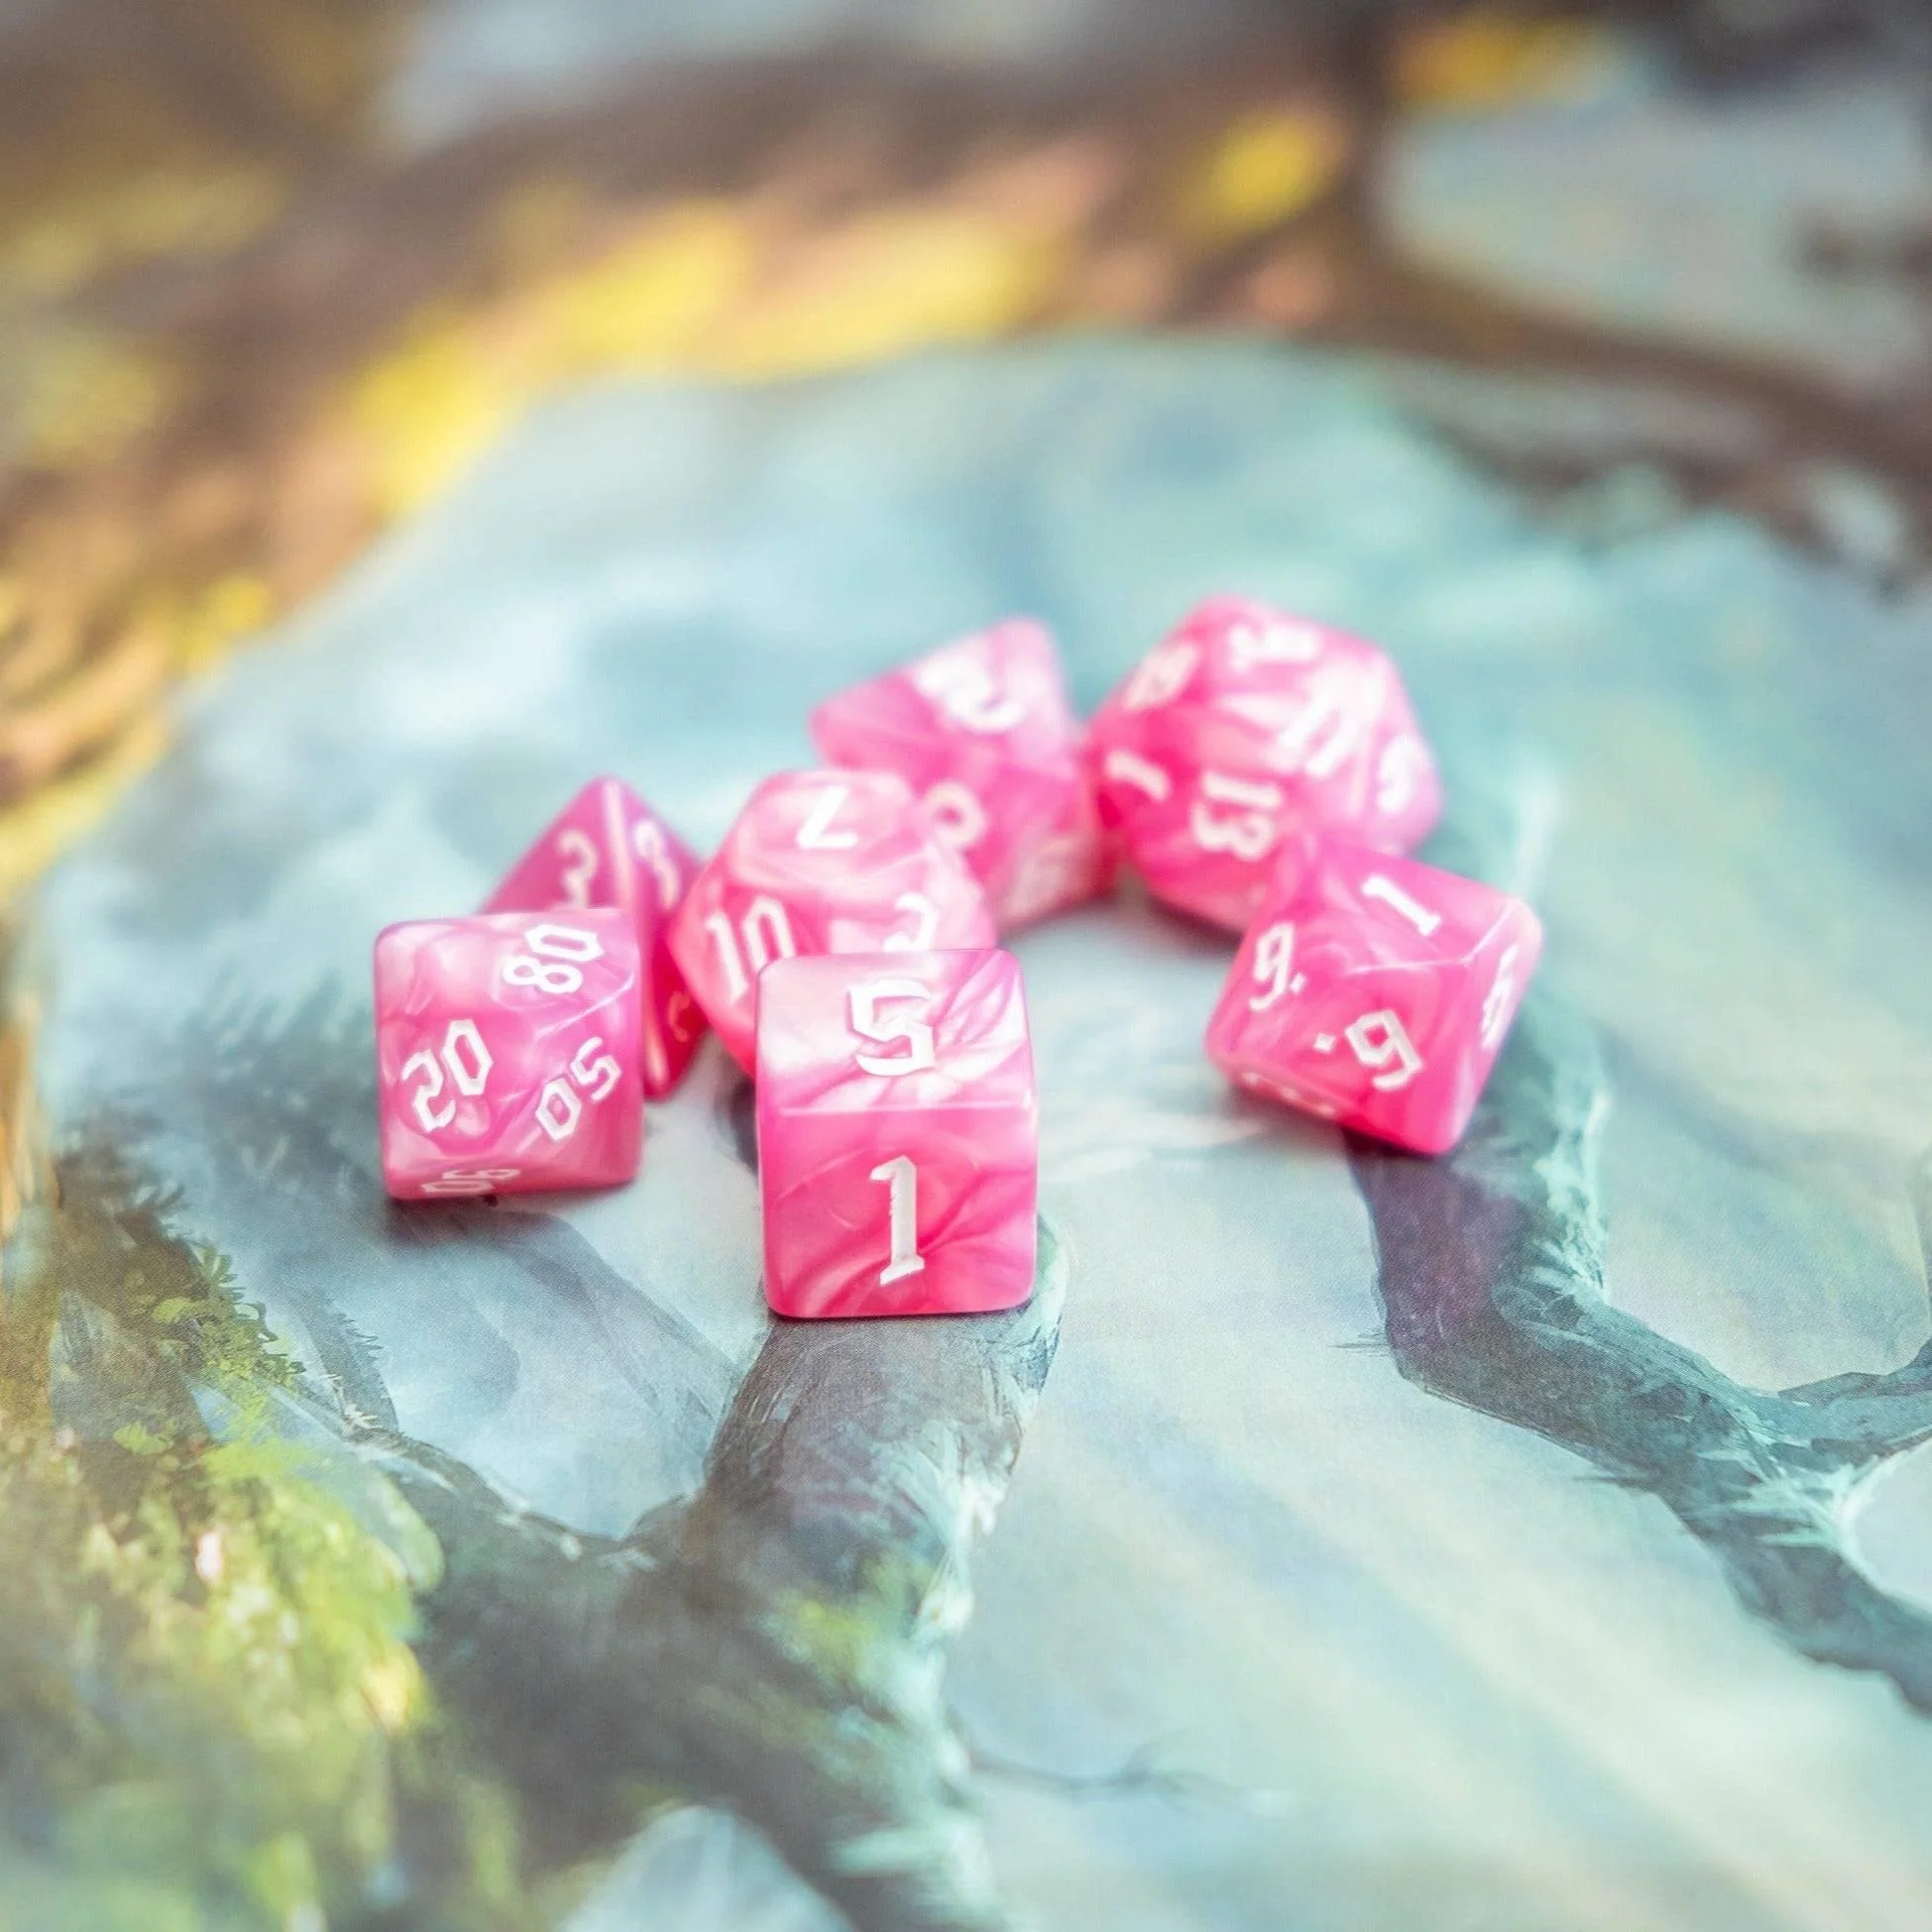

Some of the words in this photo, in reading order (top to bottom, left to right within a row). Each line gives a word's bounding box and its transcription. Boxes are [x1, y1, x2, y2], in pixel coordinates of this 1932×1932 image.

[1361, 873, 1440, 937] 1
[502, 923, 603, 994] 80
[400, 1019, 494, 1133] 20
[848, 978, 936, 1077] 5
[869, 1156, 925, 1286] 1
